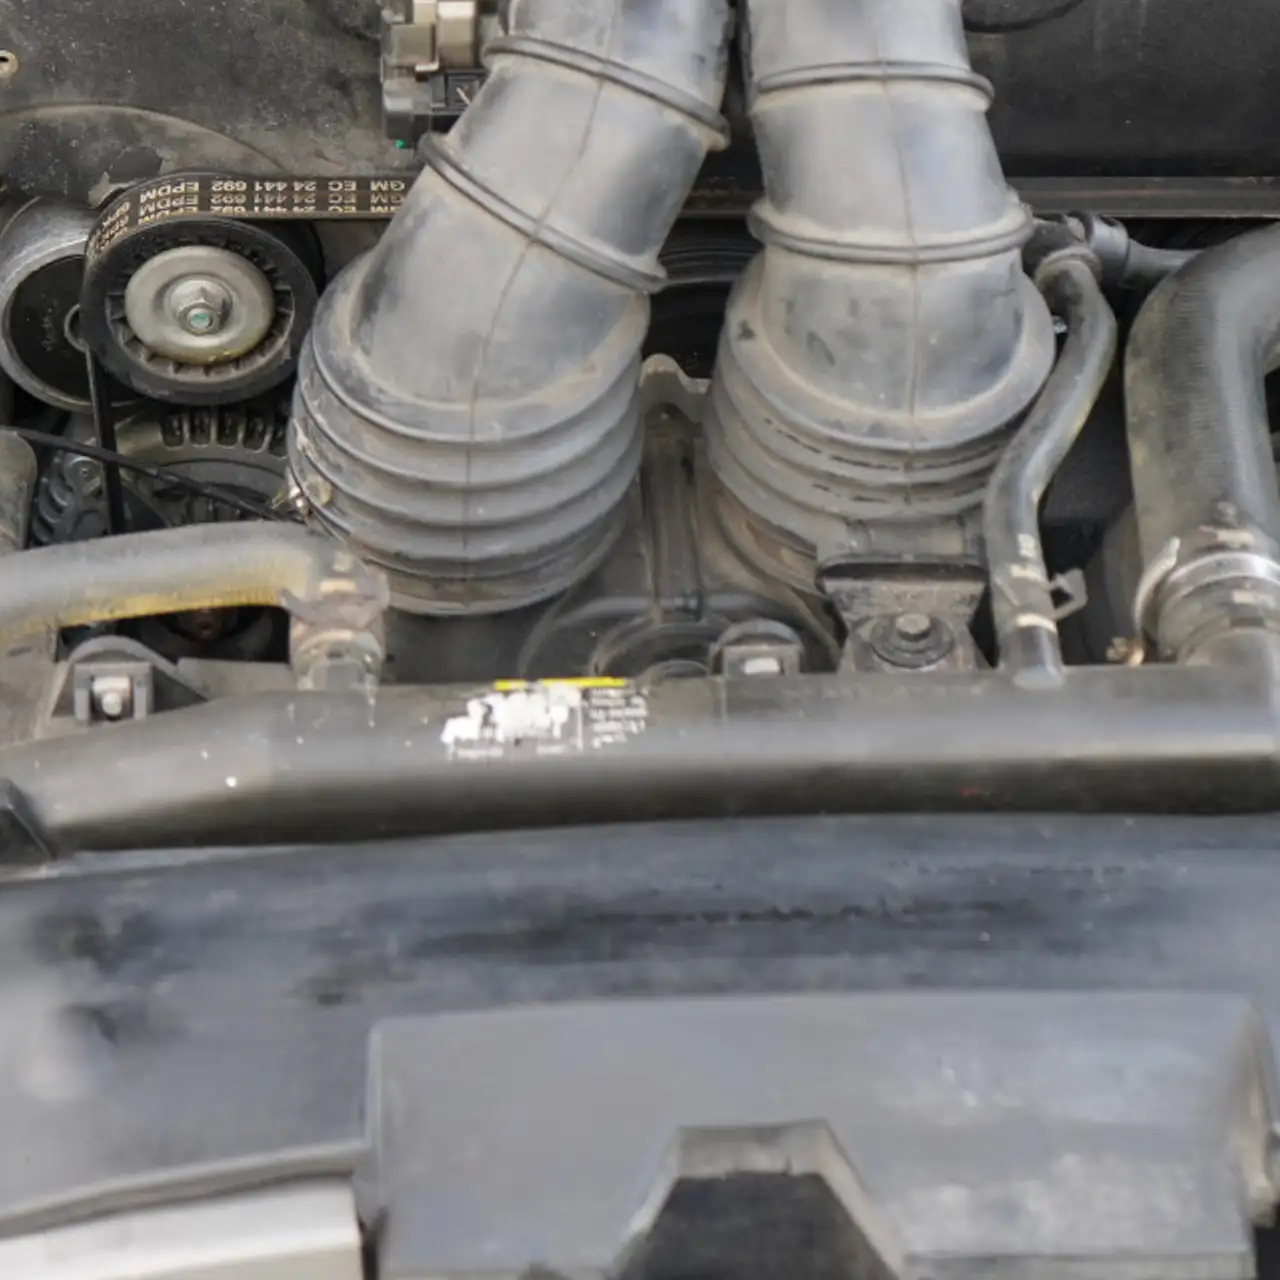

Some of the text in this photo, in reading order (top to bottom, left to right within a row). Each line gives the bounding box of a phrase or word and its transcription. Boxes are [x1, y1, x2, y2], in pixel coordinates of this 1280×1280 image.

[139, 181, 200, 203] EPDM
[211, 180, 248, 192] 692
[253, 180, 289, 192] 441
[293, 180, 317, 192] 24
[327, 180, 357, 192] EC
[369, 180, 406, 192] GM
[138, 194, 200, 215] EPDM
[253, 193, 288, 205] 441
[292, 193, 316, 205] 24
[327, 193, 357, 205] EC
[369, 193, 405, 205] GM
